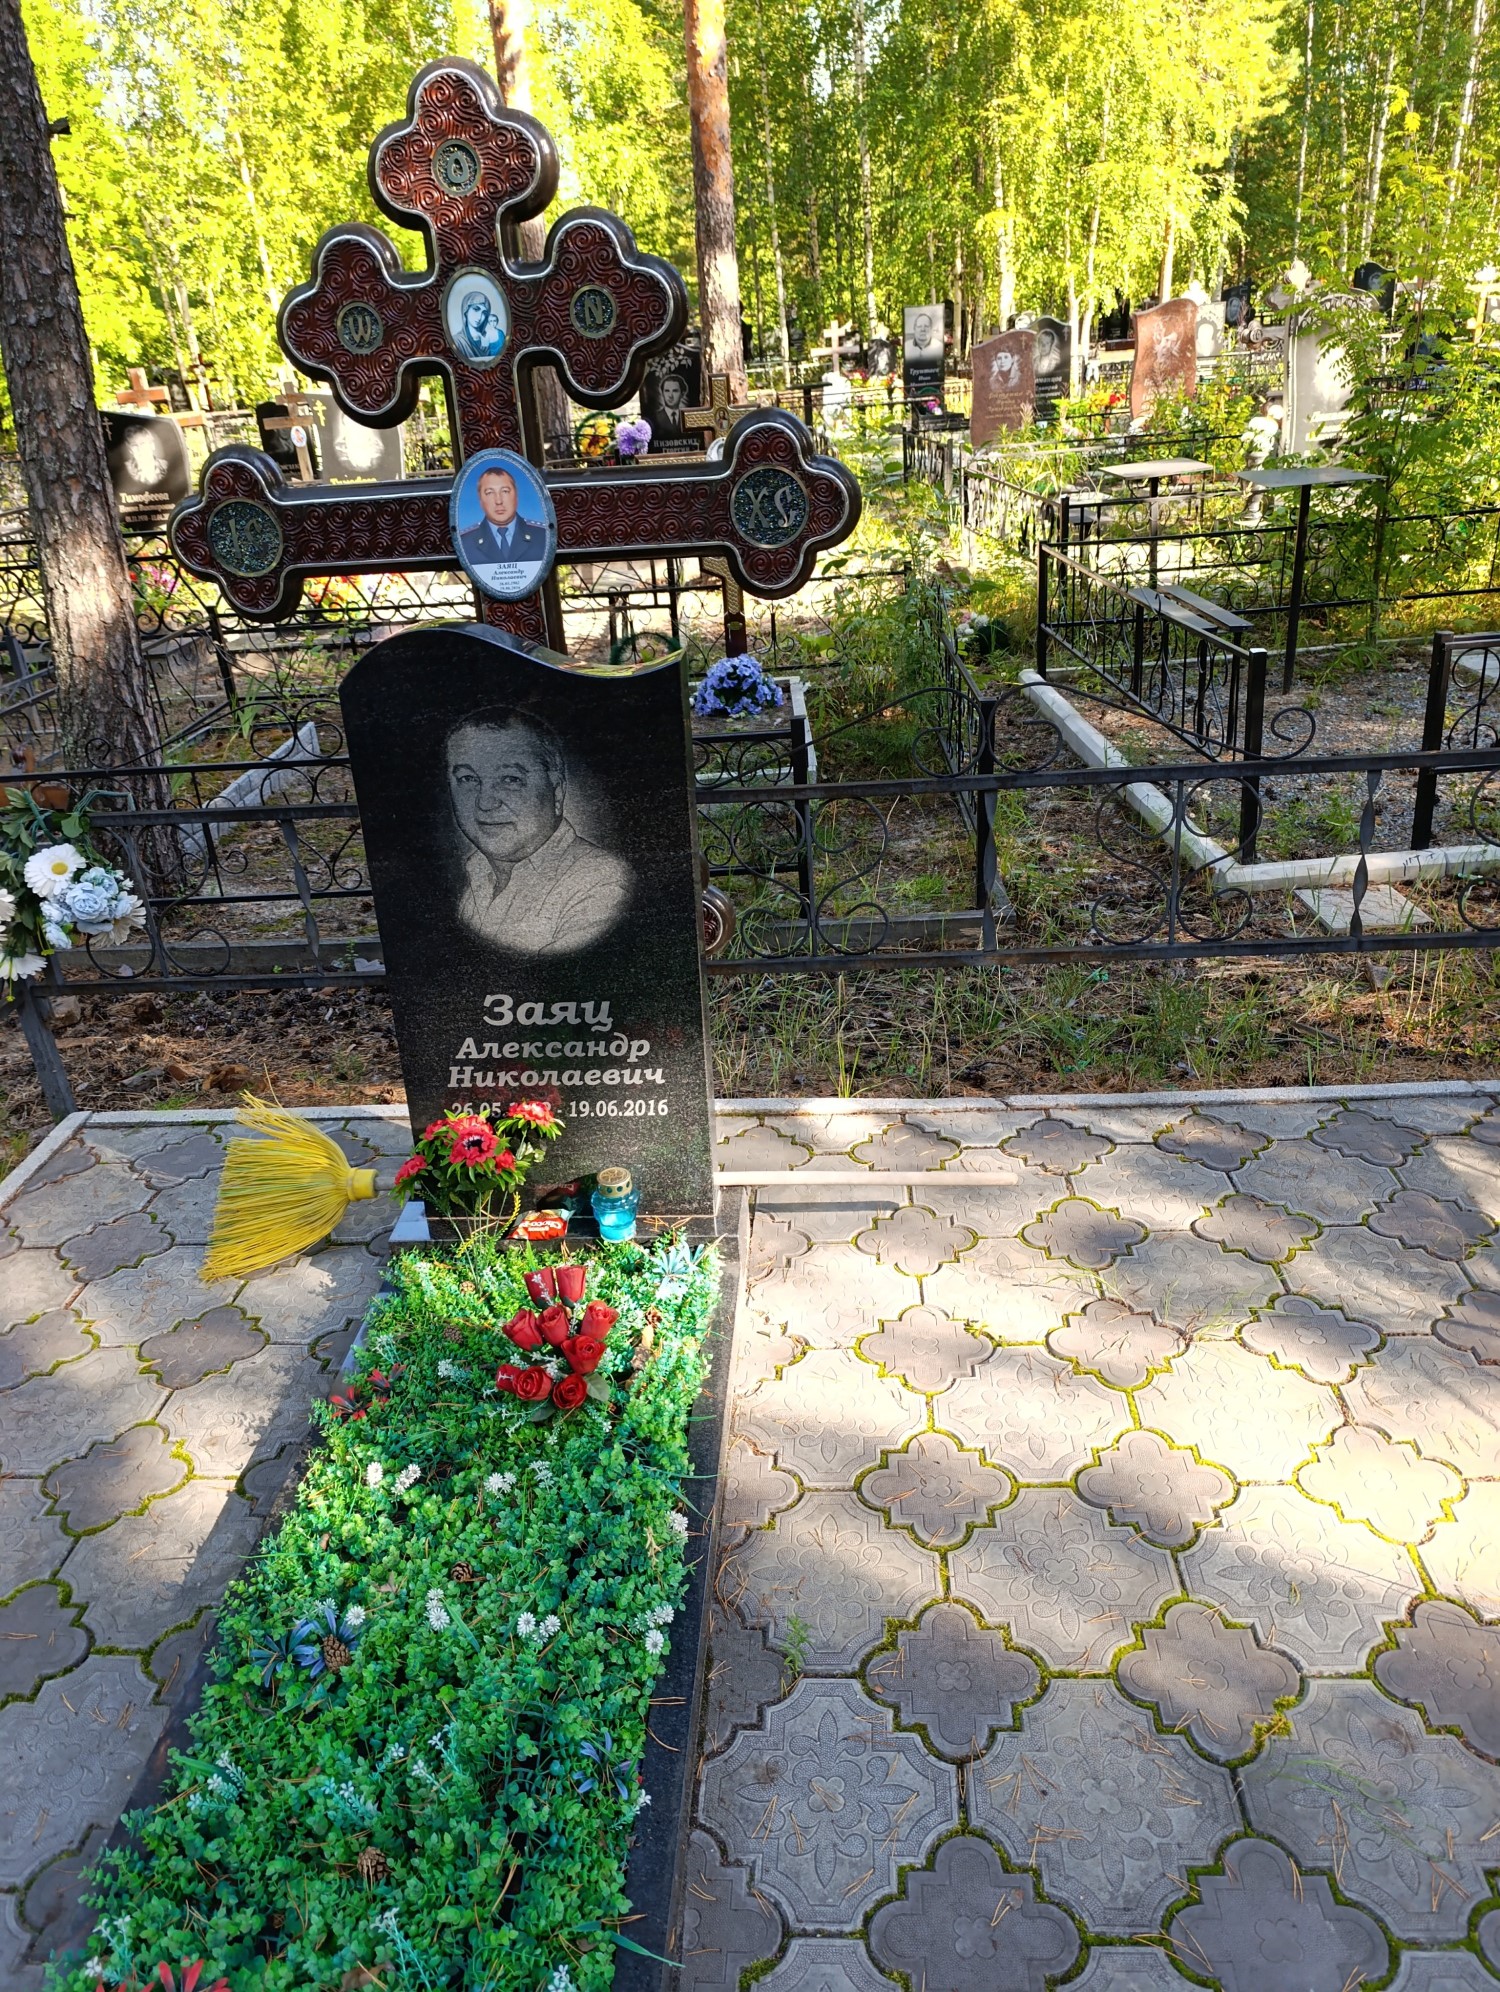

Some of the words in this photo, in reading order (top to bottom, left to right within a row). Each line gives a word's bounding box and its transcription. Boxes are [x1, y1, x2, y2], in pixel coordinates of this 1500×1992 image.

[482, 993, 614, 1032] Заяц
[455, 1031, 651, 1063] Александр
[447, 1065, 666, 1088] Николаевич
[569, 1099, 669, 1117] 19.06.2016
